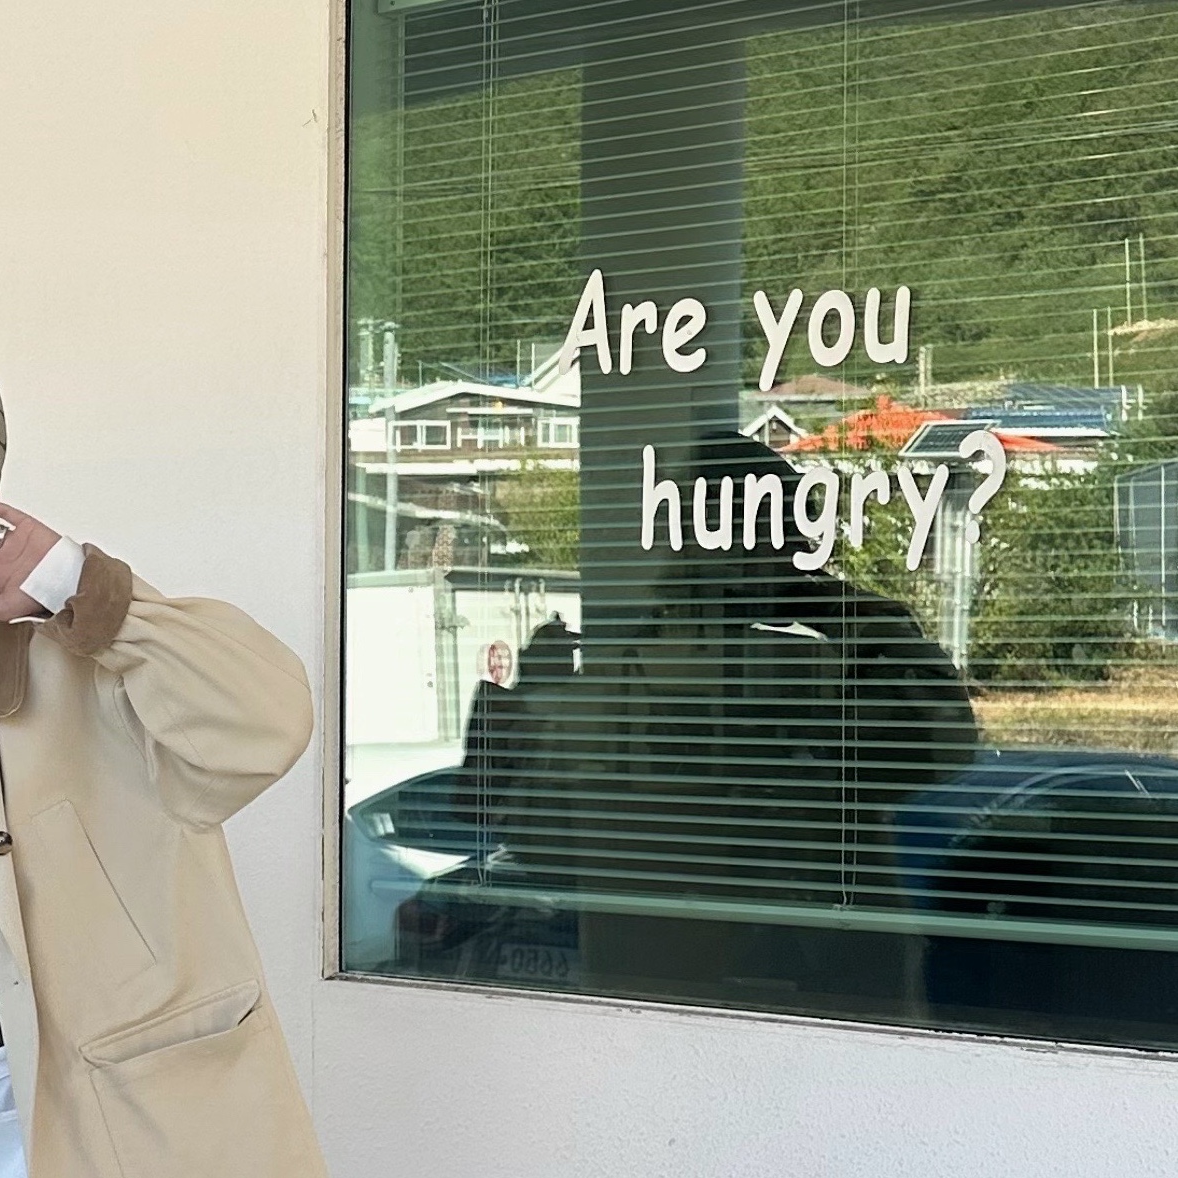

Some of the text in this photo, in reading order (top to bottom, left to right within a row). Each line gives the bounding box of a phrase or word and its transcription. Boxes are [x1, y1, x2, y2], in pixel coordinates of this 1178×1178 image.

[559, 268, 911, 392] Are you
[641, 429, 1007, 571] hungry?
